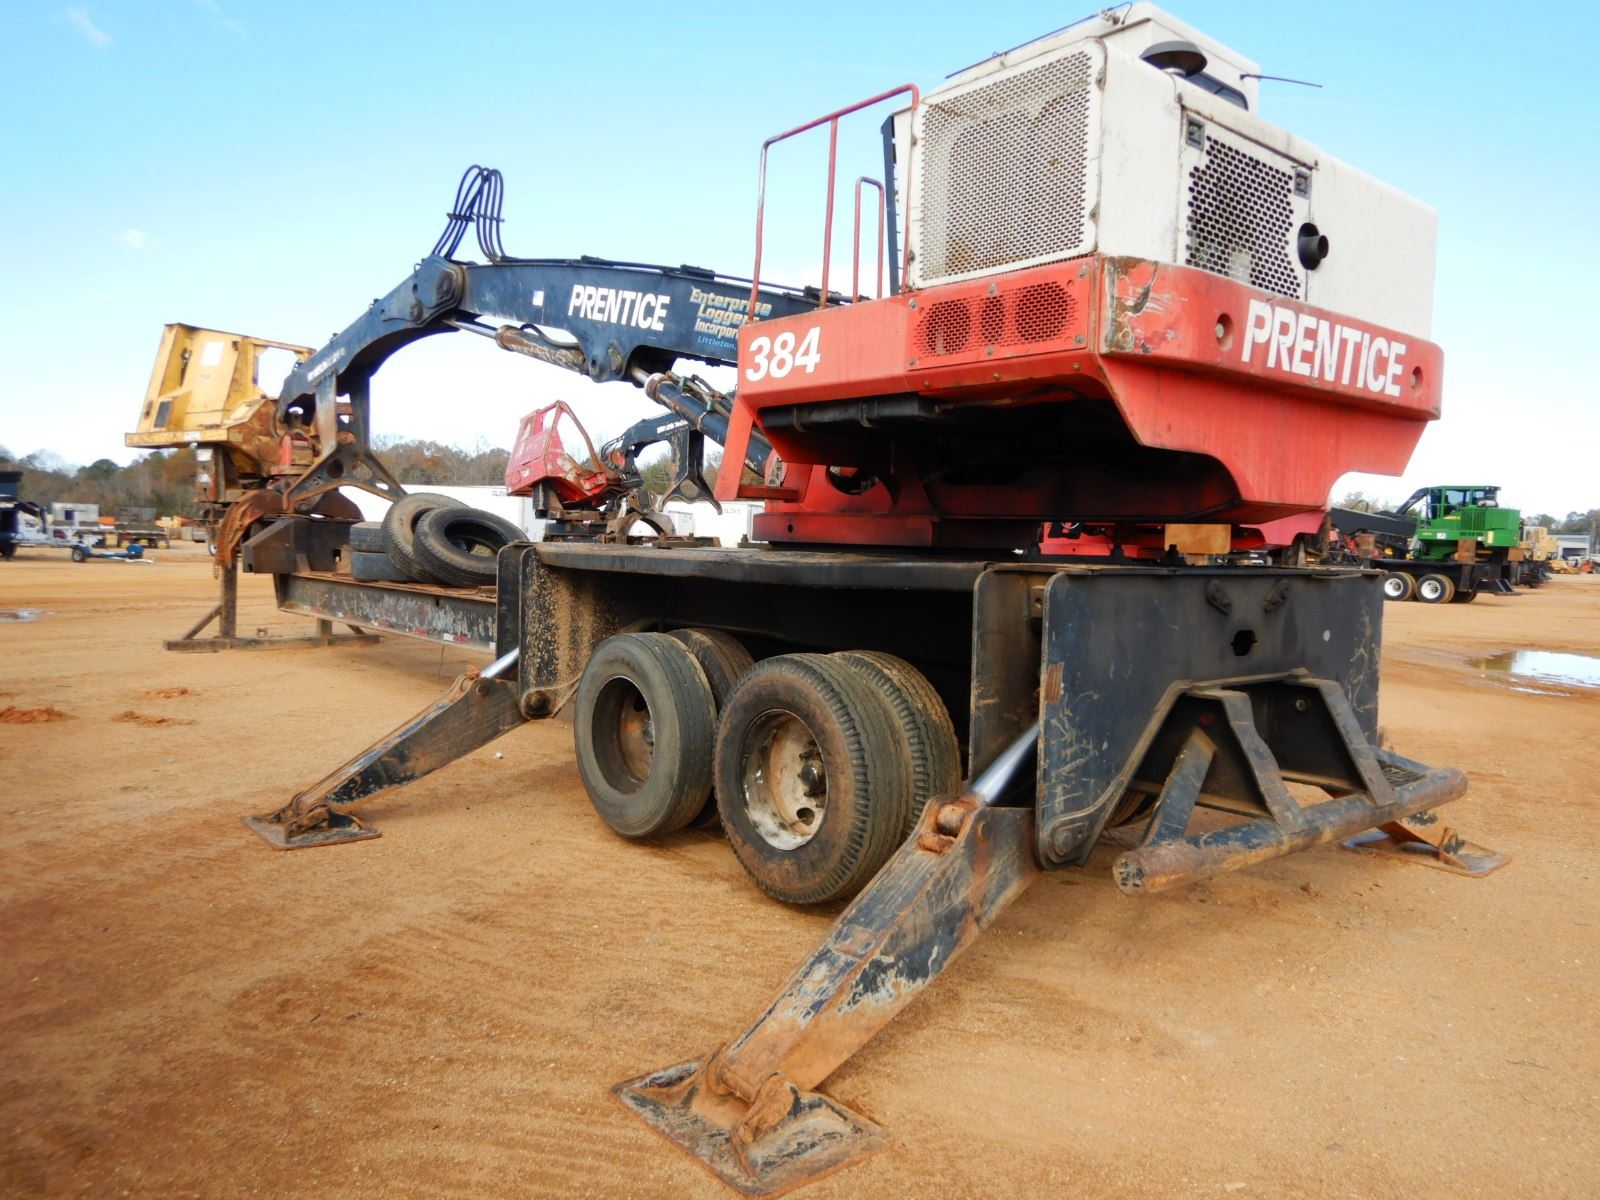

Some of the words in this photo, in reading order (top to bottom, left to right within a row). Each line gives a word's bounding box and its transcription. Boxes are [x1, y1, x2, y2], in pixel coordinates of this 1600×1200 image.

[568, 284, 671, 331] PRENTICE
[745, 326, 821, 382] 384
[1241, 298, 1407, 397] PRENTICE
